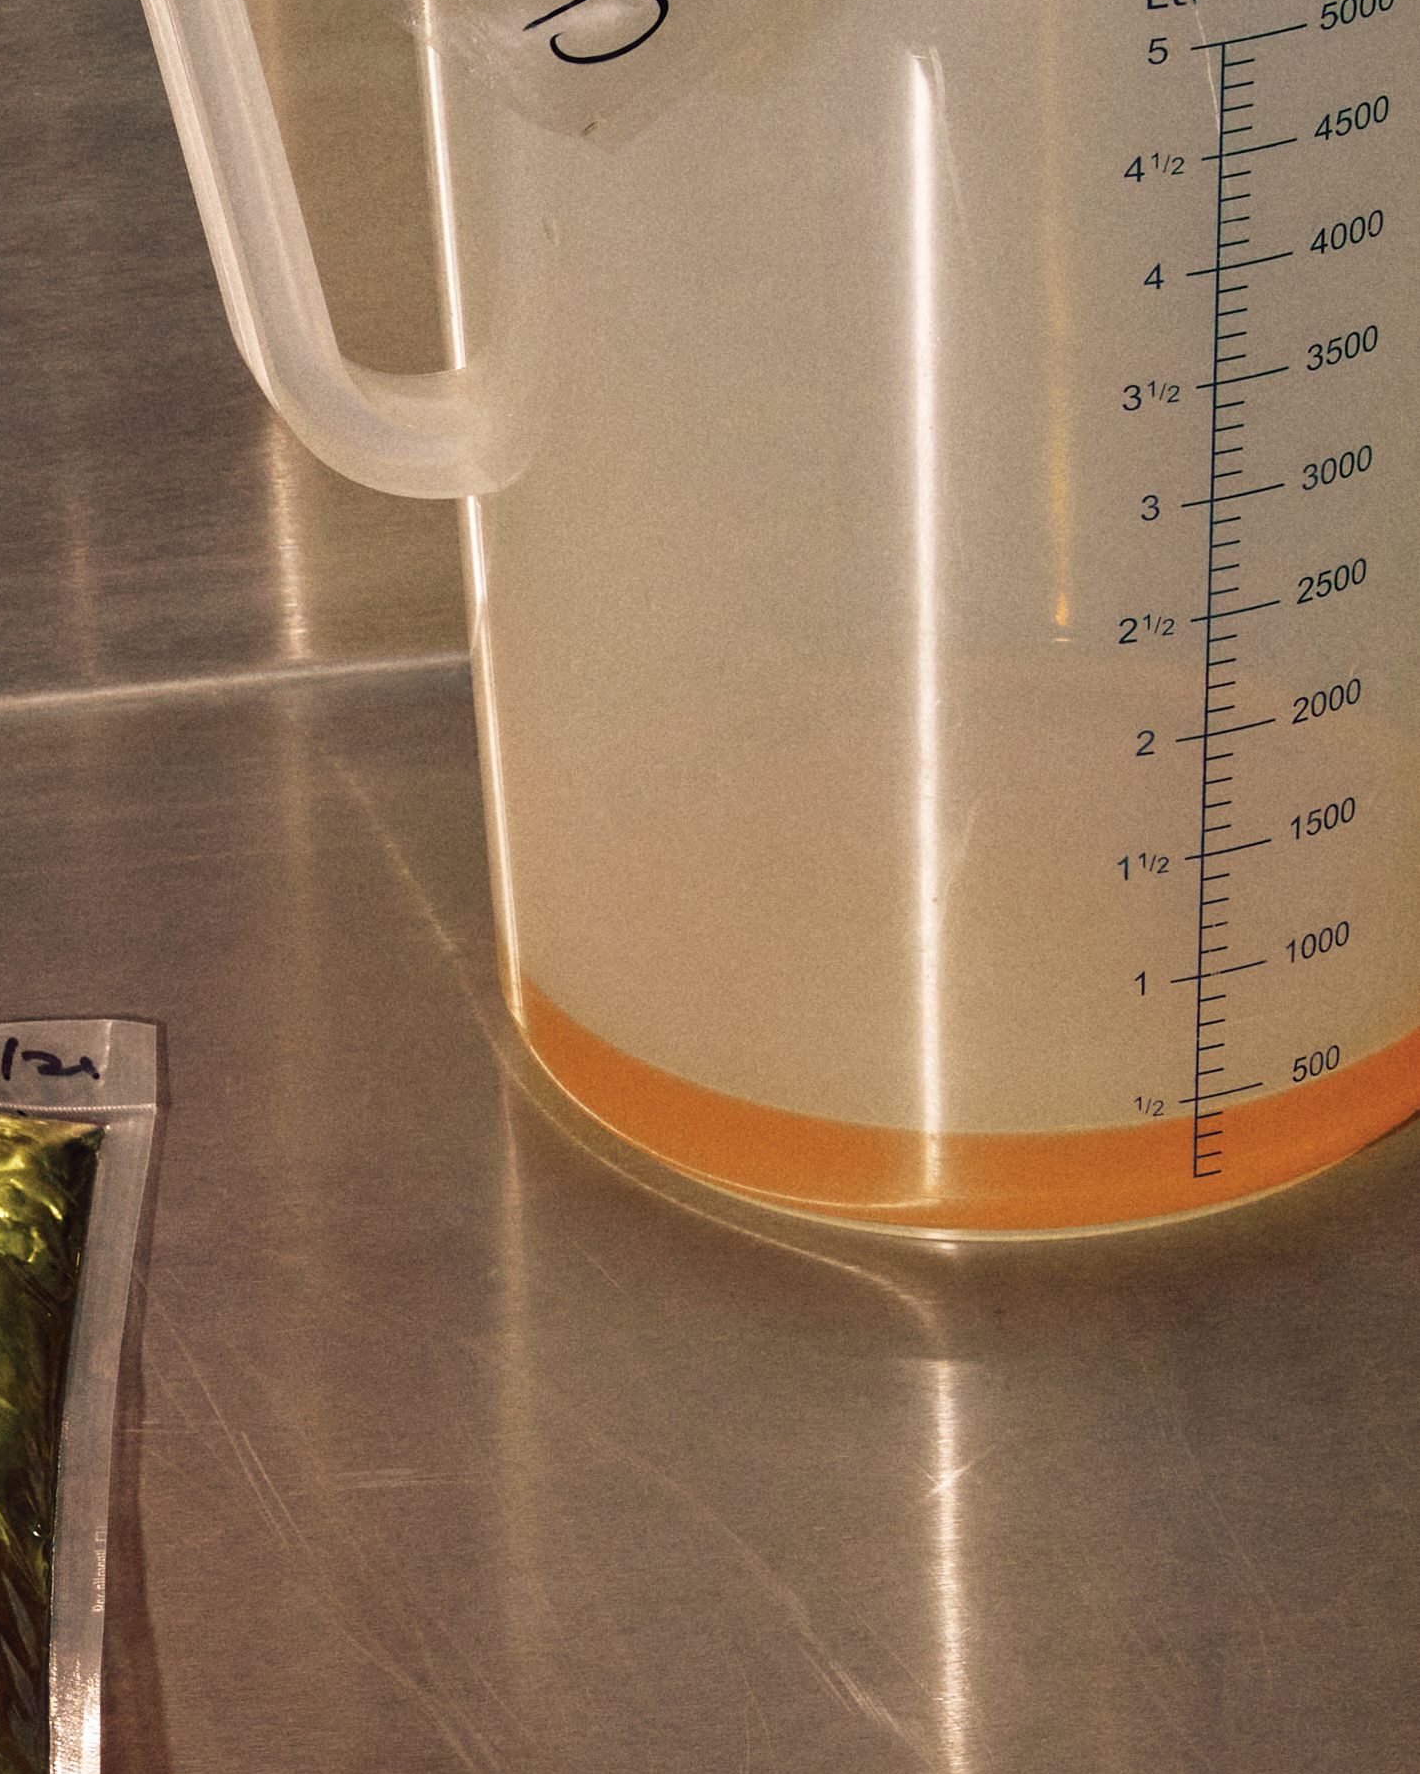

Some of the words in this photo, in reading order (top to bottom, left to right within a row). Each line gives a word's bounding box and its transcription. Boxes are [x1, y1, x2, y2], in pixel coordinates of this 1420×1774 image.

[1147, 36, 1169, 66] 5
[1313, 94, 1390, 141] 4500
[1309, 208, 1385, 256] 4000
[1143, 262, 1165, 291] 4
[1305, 324, 1379, 372] 3500
[1301, 444, 1373, 491] 3000
[1140, 494, 1161, 522] 3
[1296, 557, 1368, 606] 2500
[1291, 677, 1362, 726] 2000
[1135, 729, 1156, 758] 2
[1290, 796, 1357, 841] 1500
[1285, 920, 1350, 964] 1000
[1134, 970, 1147, 997] 1
[1291, 1044, 1341, 1083] 500
